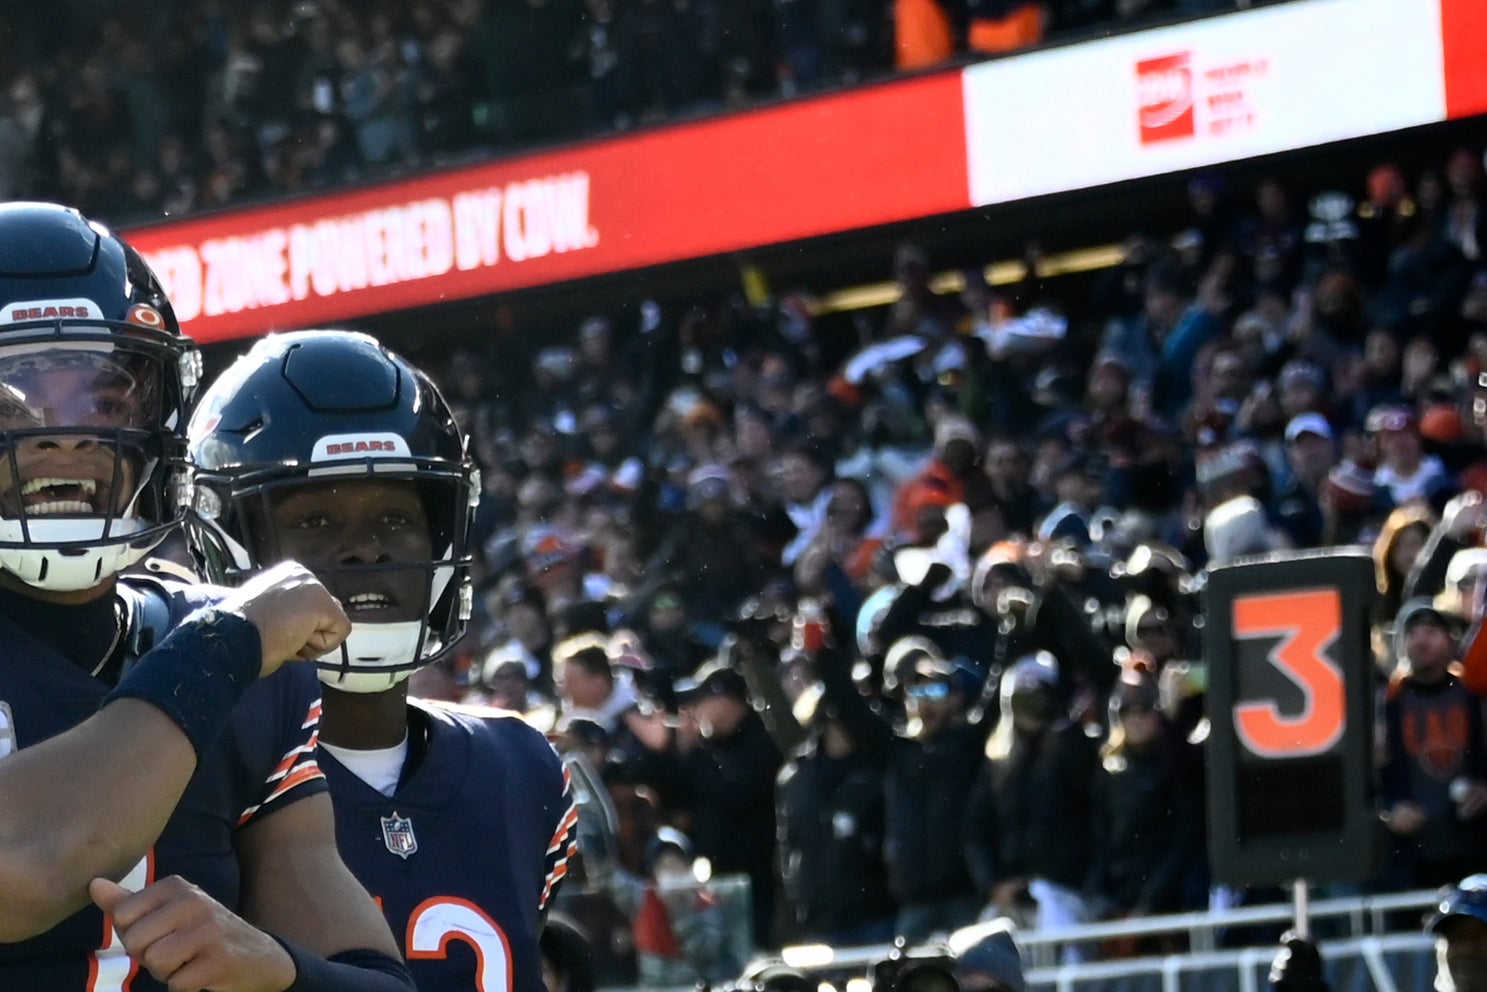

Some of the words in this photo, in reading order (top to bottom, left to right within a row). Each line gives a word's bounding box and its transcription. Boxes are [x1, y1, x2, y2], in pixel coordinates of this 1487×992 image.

[144, 246, 202, 322] ED
[200, 235, 290, 317] ZONE
[289, 198, 454, 301] POWERED
[453, 186, 503, 271] BY
[12, 306, 90, 321] BEARS
[326, 440, 396, 455] BEARS
[1232, 588, 1347, 759] 3
[390, 832, 414, 851] NFL
